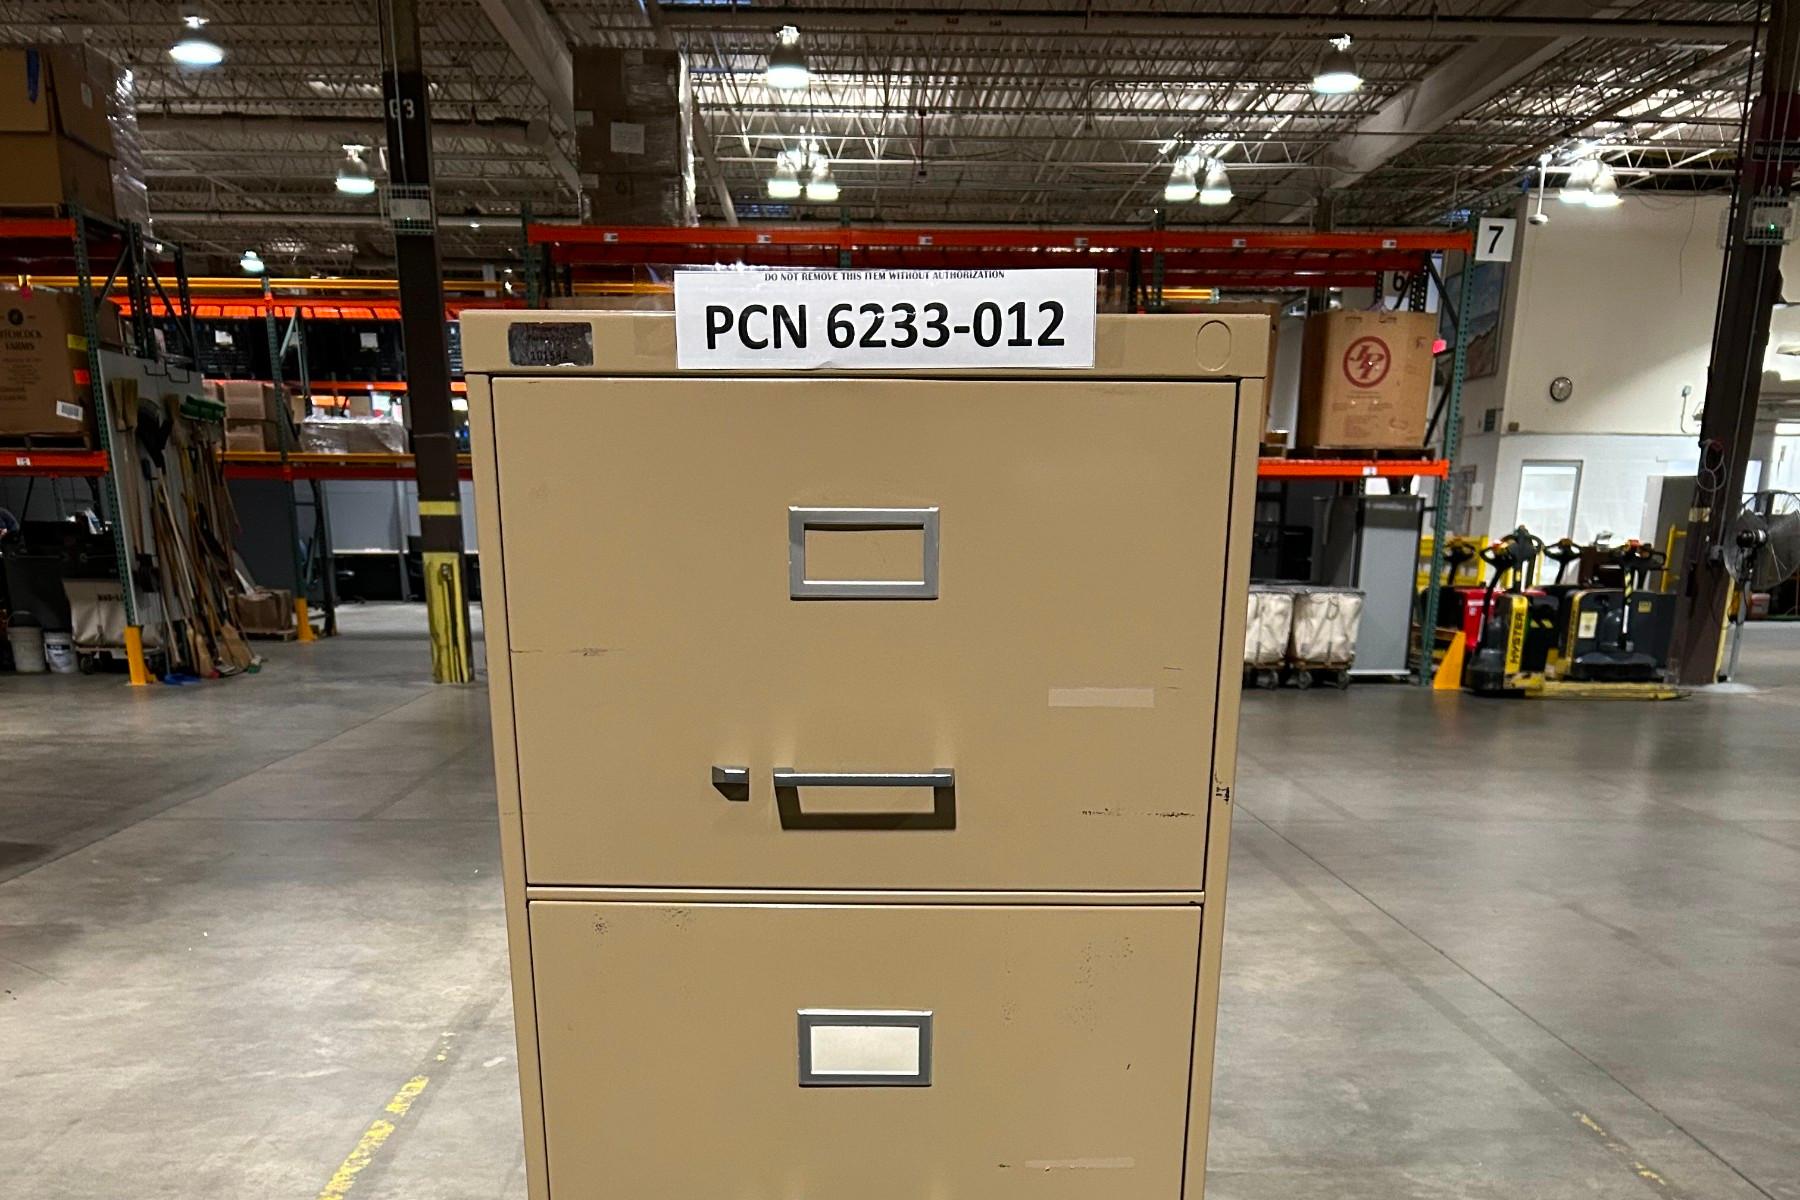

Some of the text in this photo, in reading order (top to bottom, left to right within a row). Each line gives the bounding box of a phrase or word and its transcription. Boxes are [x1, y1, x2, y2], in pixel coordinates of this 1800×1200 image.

[1487, 224, 1505, 255] 7
[764, 270, 1005, 282] DO NOT REMOVE THIS ITEM WITHOUT AUTHORIZATION
[706, 301, 1065, 350] PCN 6233-012
[1510, 612, 1524, 664] HYSTER
